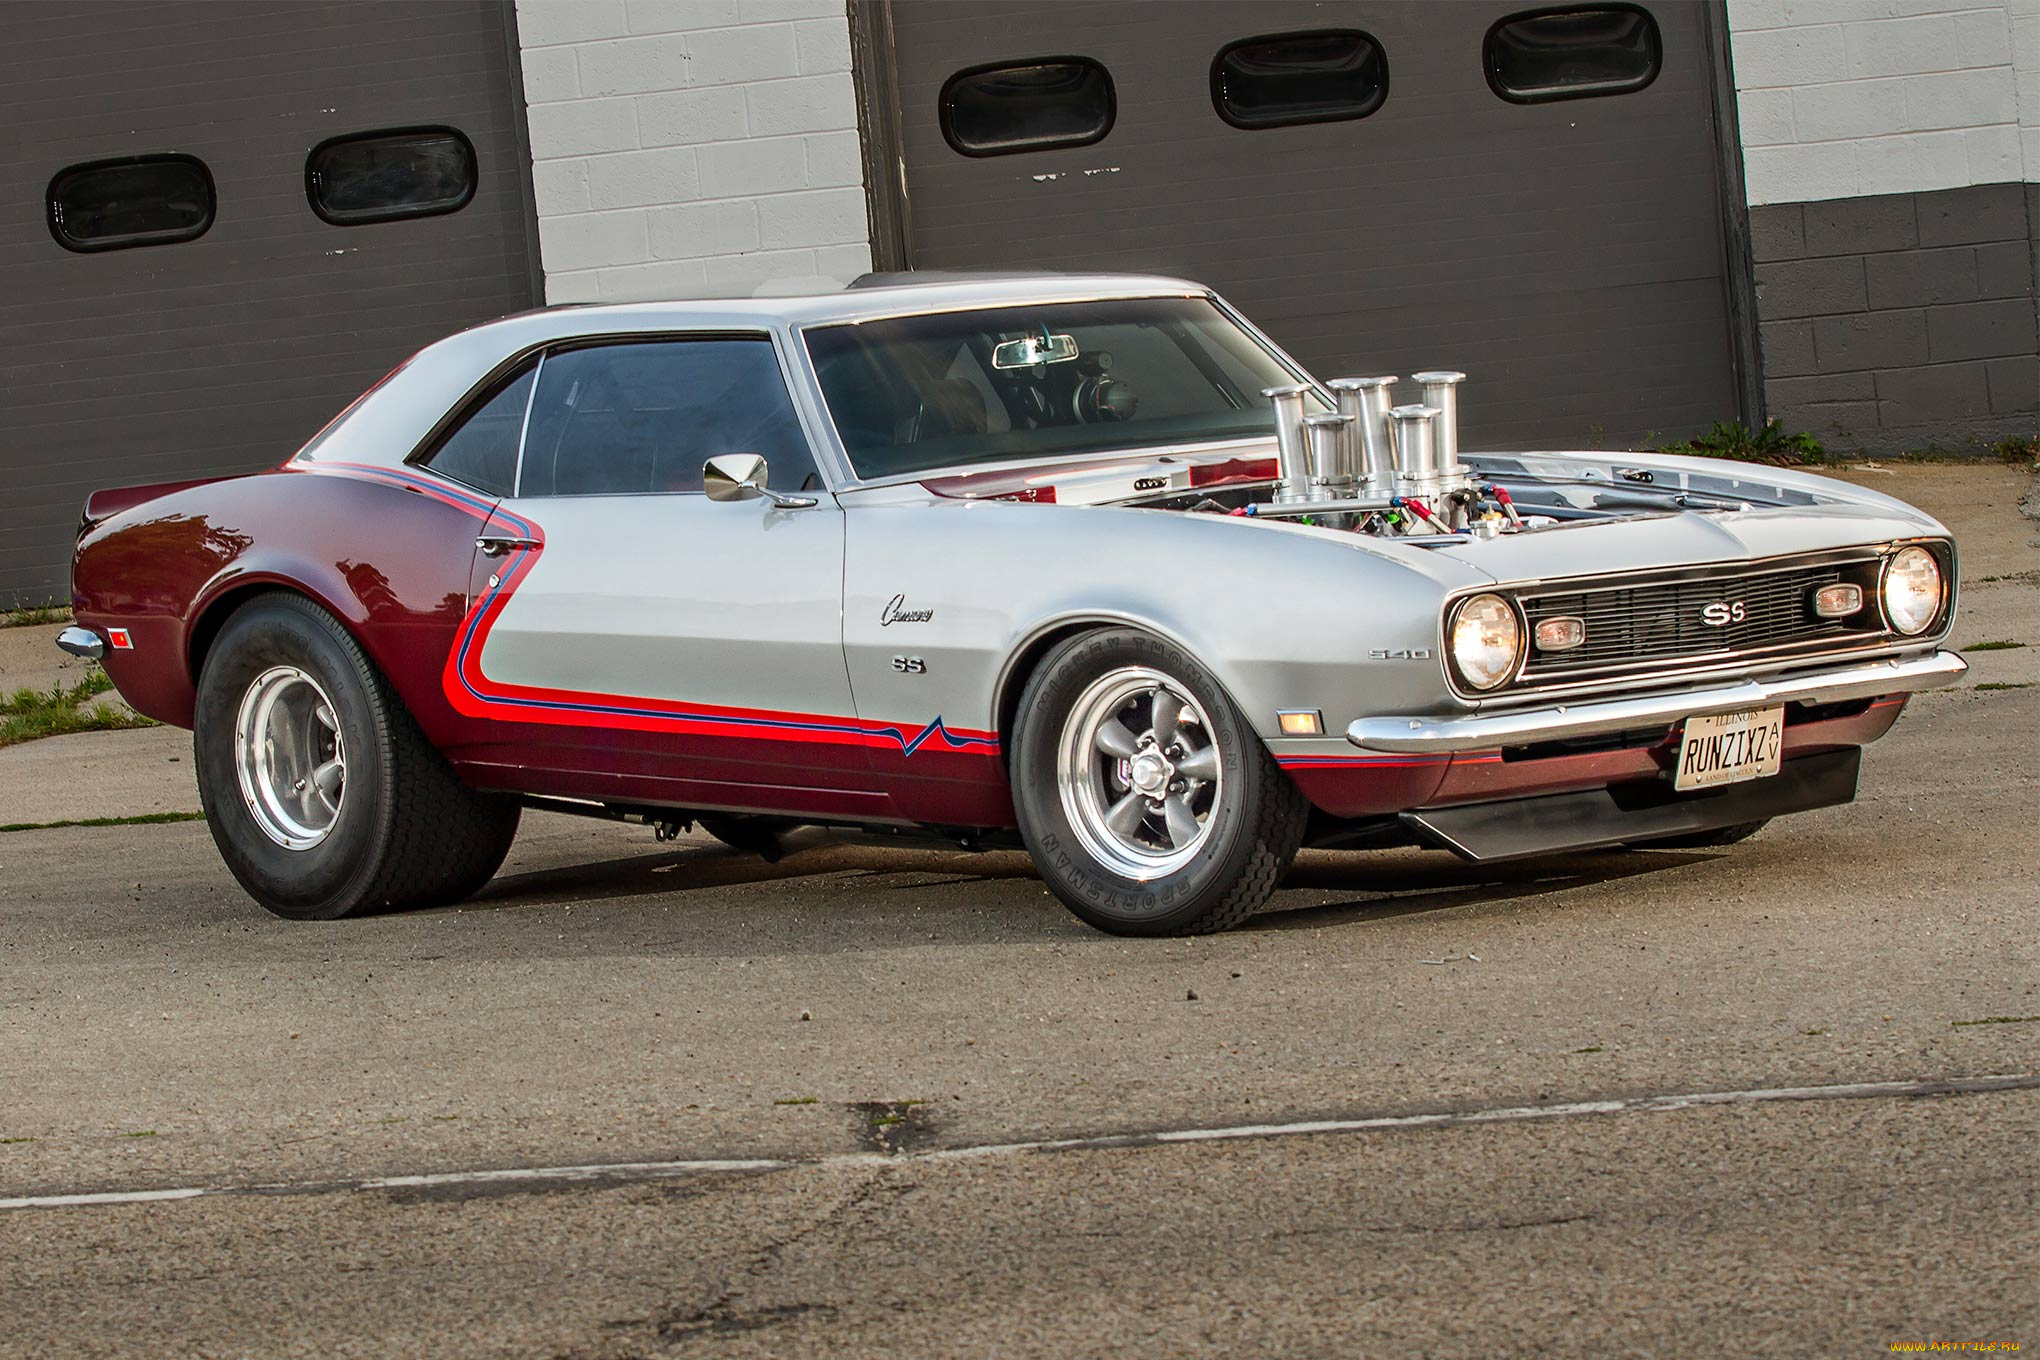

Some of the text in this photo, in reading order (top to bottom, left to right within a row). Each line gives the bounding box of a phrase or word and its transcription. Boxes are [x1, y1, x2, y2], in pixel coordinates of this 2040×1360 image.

[1702, 602, 1746, 626] SS
[890, 655, 926, 674] SS
[1037, 636, 1120, 715] MICKEY
[1715, 710, 1759, 727] ILLINOIS
[1684, 726, 1767, 775] RUNZIXZ
[1040, 832, 1191, 911] SPORTSMAN
